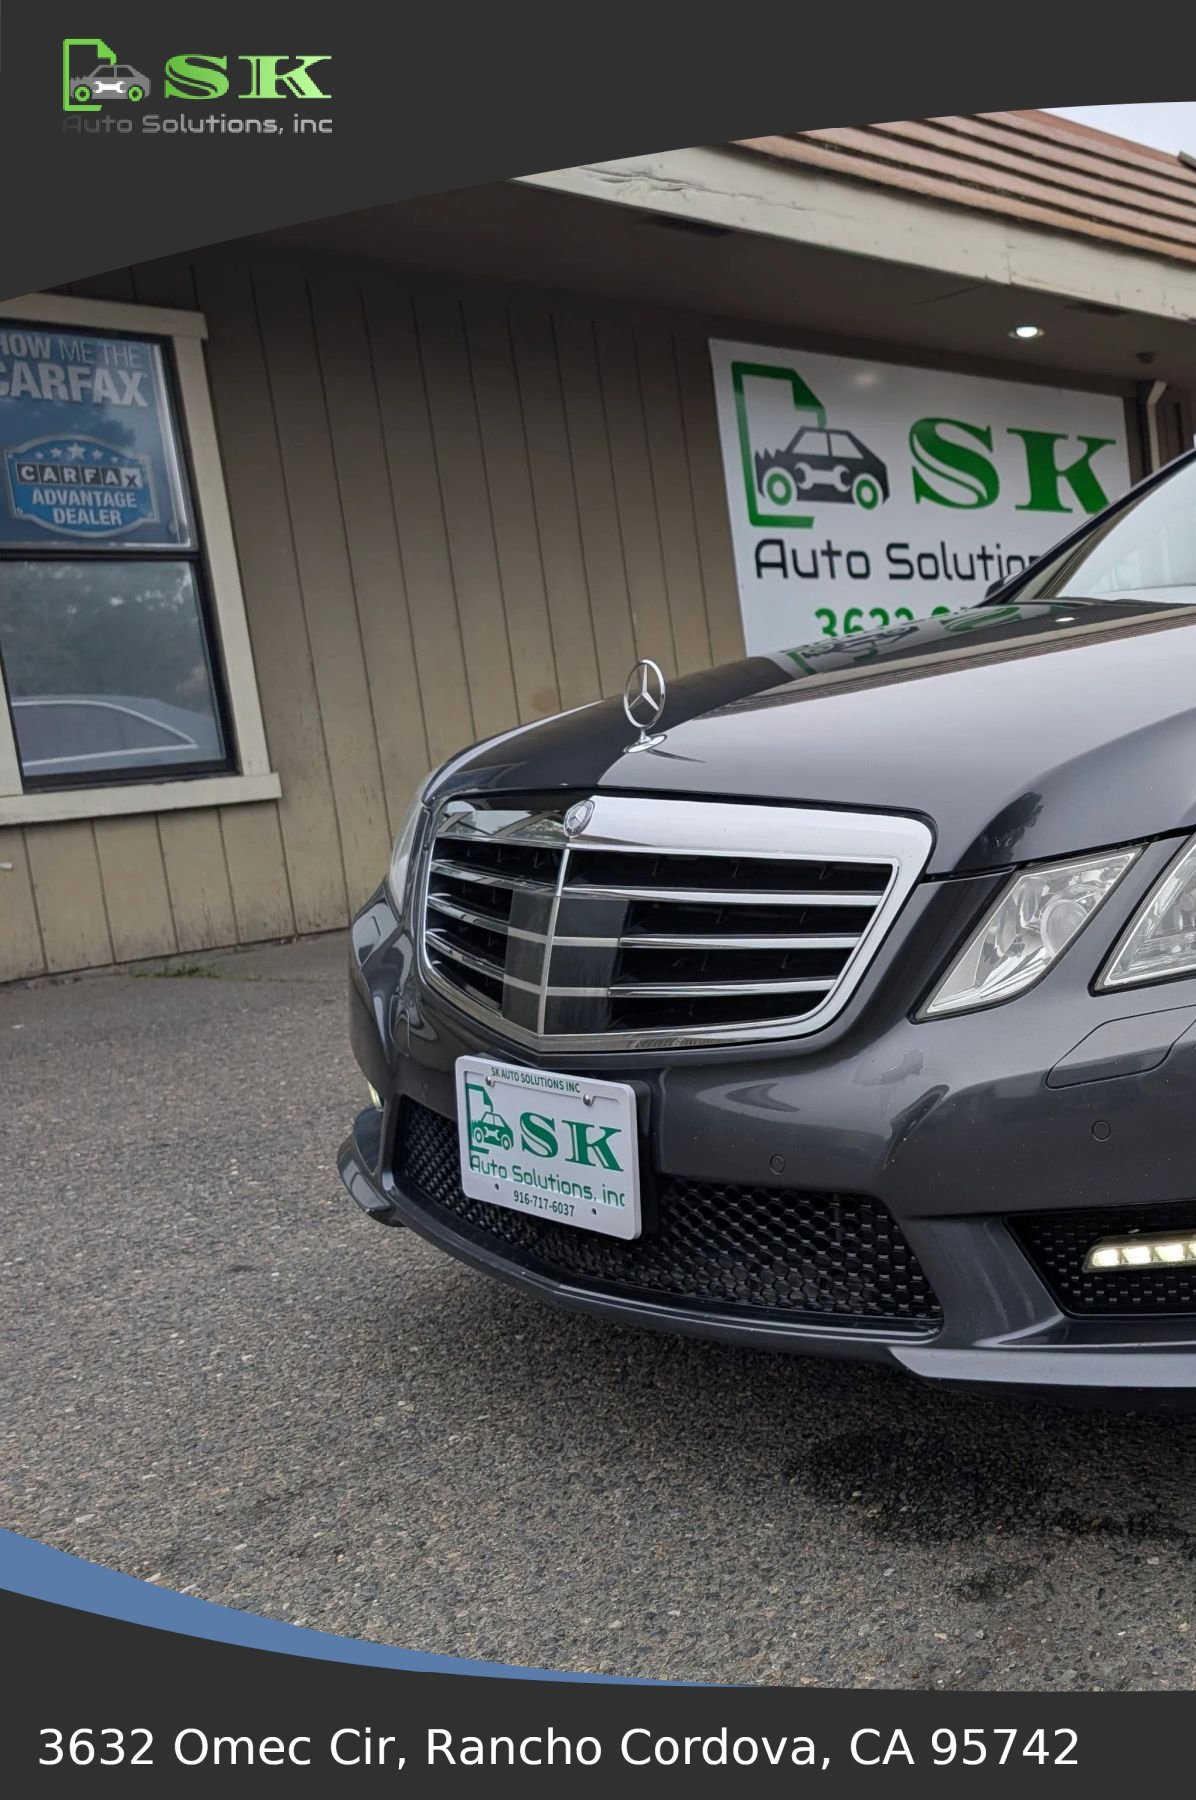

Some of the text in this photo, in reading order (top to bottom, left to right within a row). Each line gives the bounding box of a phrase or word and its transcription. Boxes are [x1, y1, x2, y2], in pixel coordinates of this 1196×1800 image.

[59, 339, 96, 363] ME
[100, 342, 141, 369] THE
[20, 465, 138, 488] CARFAX
[909, 417, 1116, 514] SK
[32, 488, 138, 508] ADVANTAGE
[52, 508, 122, 526] DEALER
[755, 538, 1041, 581] Auto Solutio
[491, 1066, 581, 1094] SK AUTO SOLUTIONS INC
[519, 1111, 625, 1172] SK
[470, 1154, 508, 1180] Auto
[512, 1164, 598, 1202] Solutions,
[513, 1190, 575, 1217] 916-717-6037
